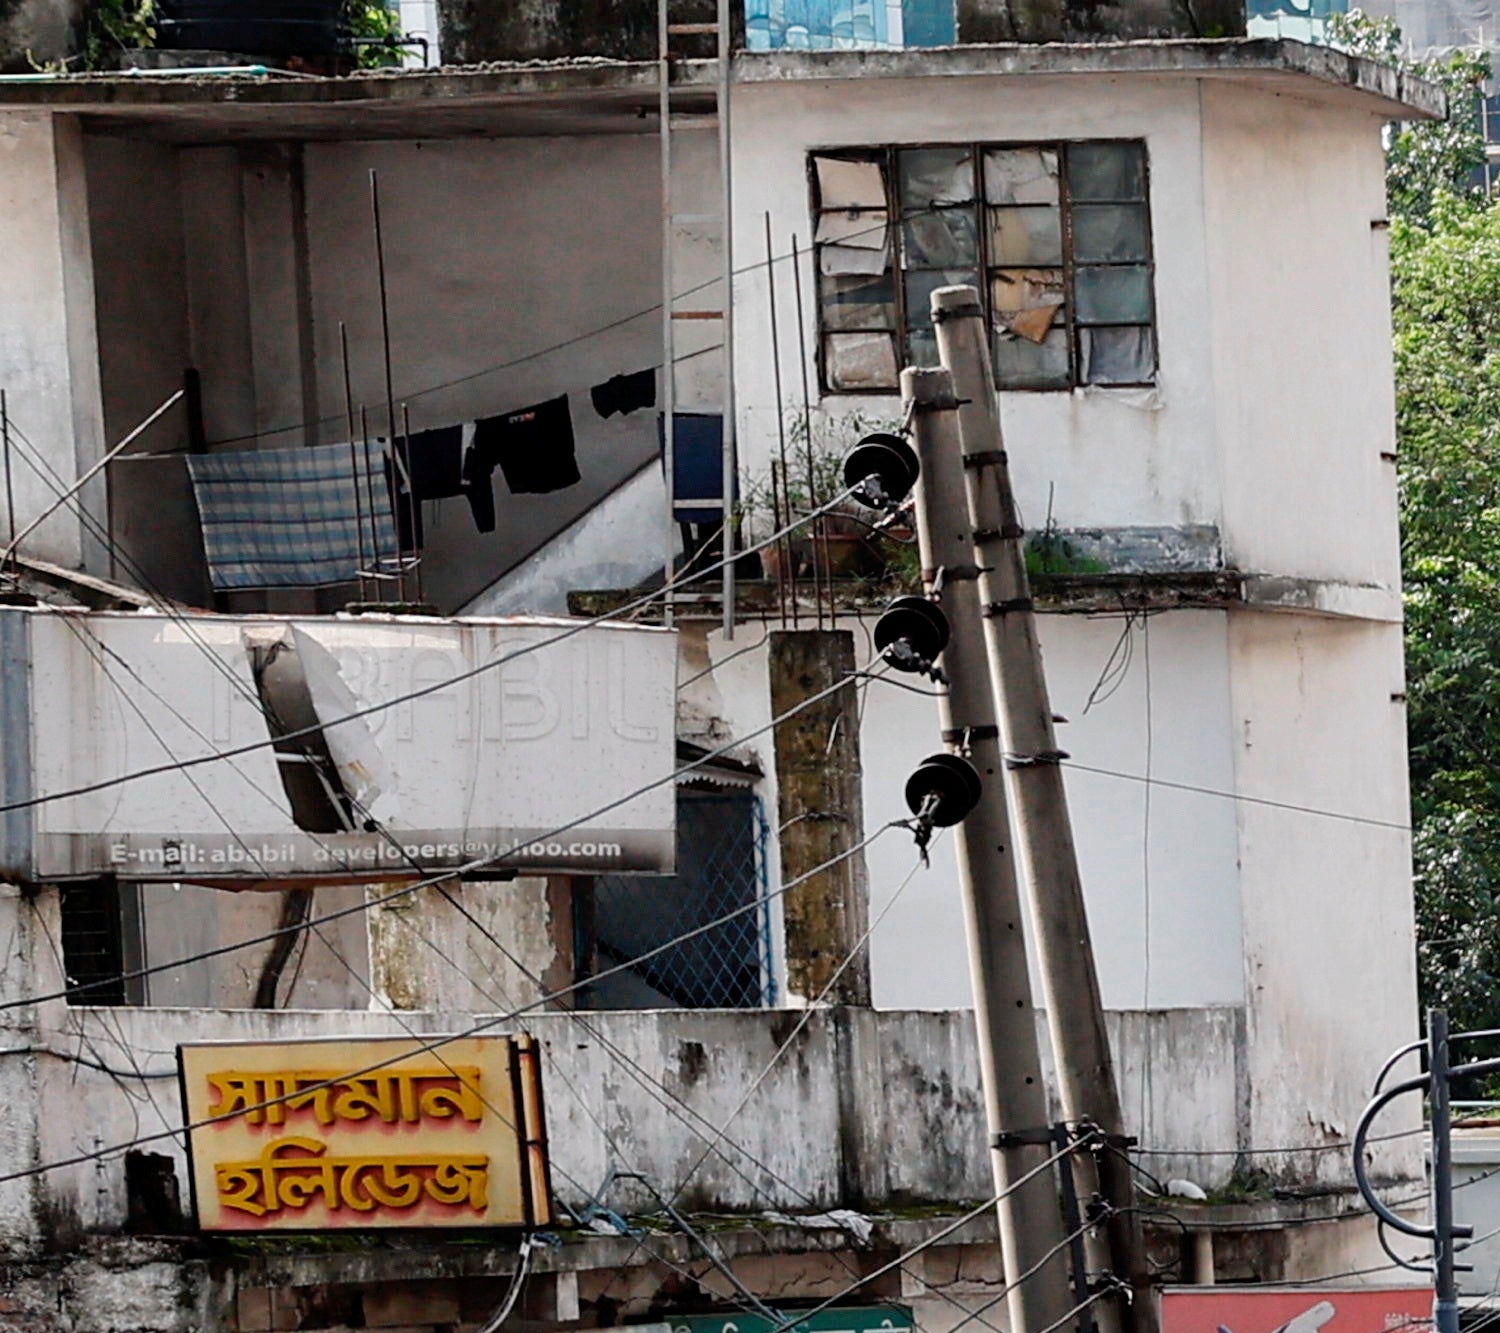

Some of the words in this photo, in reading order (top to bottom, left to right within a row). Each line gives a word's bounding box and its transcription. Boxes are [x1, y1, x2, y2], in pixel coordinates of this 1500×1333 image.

[110, 842, 204, 864] E-mail:
[207, 1066, 483, 1126] সাদমান
[213, 1136, 490, 1215] হলিডেজ
